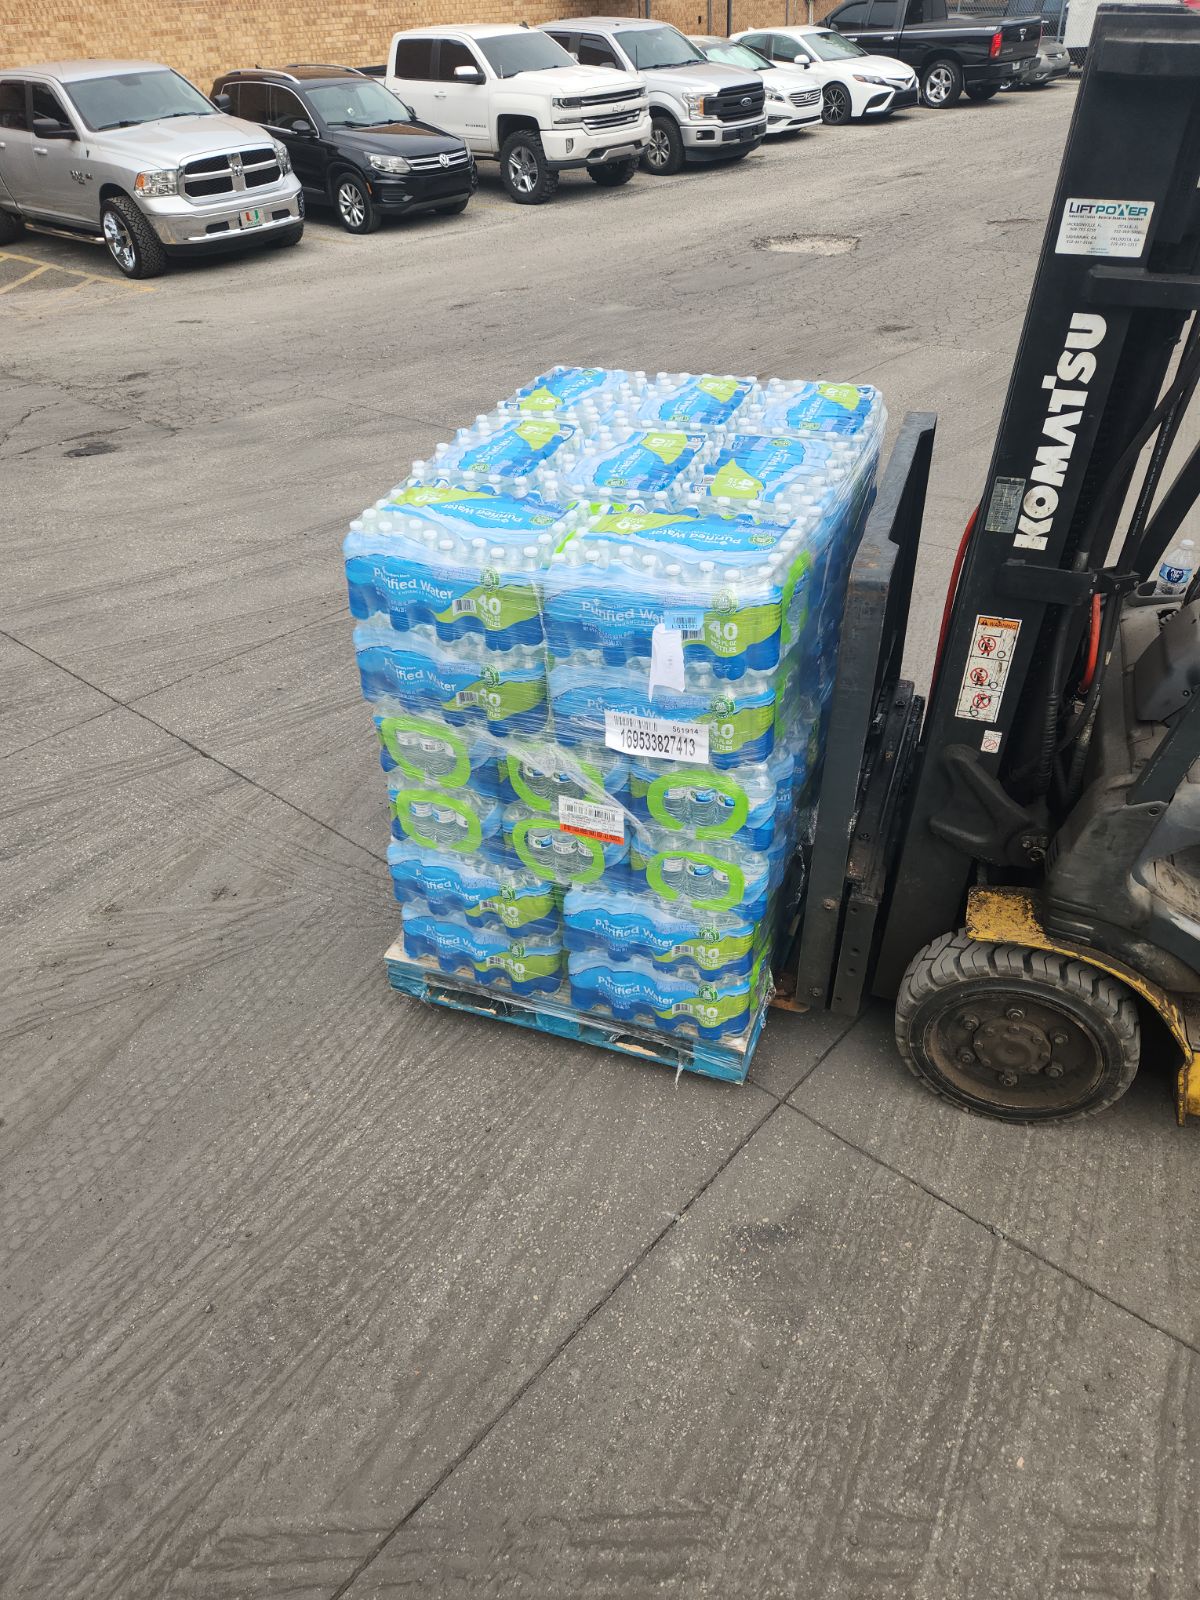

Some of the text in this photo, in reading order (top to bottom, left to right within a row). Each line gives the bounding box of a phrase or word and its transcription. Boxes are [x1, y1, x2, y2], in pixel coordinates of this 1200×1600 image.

[1012, 312, 1107, 550] KOMATSU
[420, 579, 454, 600] Water
[639, 608, 665, 625] Wat
[708, 620, 738, 641] 40
[384, 657, 424, 681] Pified
[620, 729, 696, 756] 169533827413
[672, 725, 699, 735] 561914
[416, 869, 481, 902] Pified Wter
[426, 925, 489, 957] Pified Wter
[595, 918, 674, 948] Purified Water
[597, 975, 675, 1005] Purified Water
